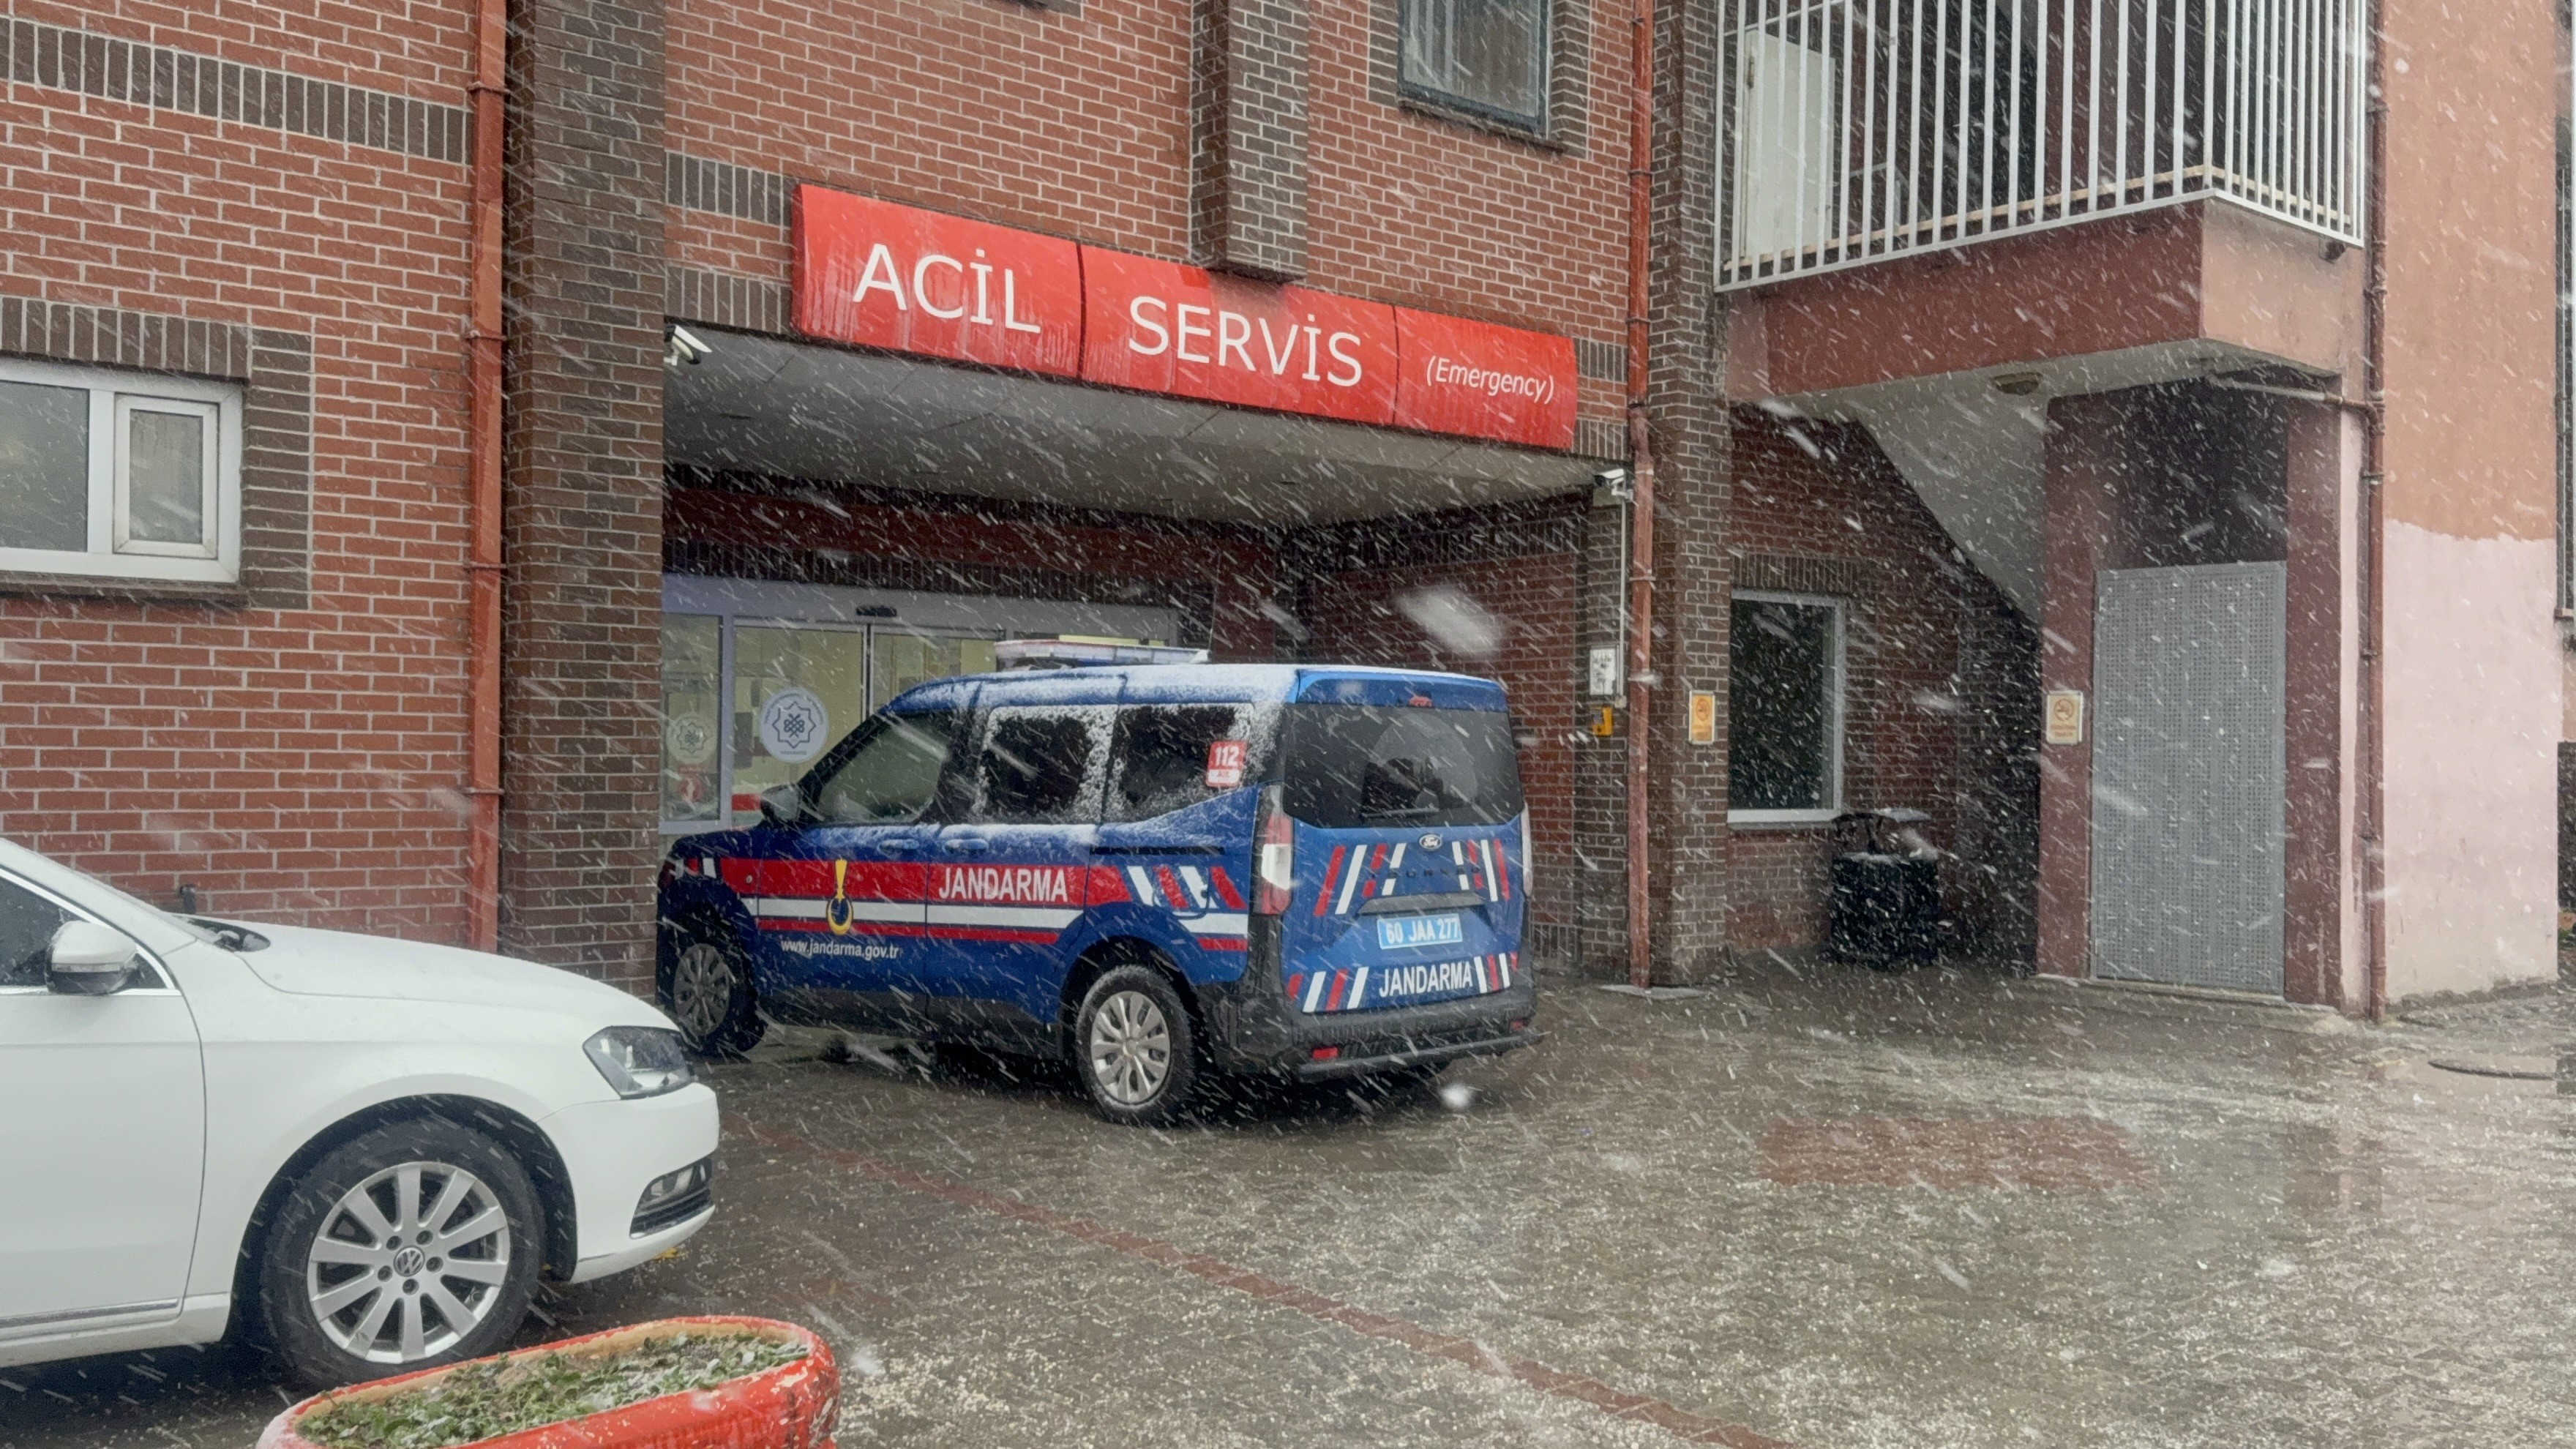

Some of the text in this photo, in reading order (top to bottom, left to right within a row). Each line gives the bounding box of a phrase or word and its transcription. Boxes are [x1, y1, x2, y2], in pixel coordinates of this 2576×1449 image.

[852, 243, 1554, 405] ACİL SERVİS (Emergency)
[1215, 744, 1240, 768] 112
[938, 866, 1068, 903] JANDARMA
[1385, 917, 1459, 944] 60 JAA 277
[781, 939, 899, 961] www.jandarma.gov.tr
[1379, 960, 1473, 997] JANDARMA
